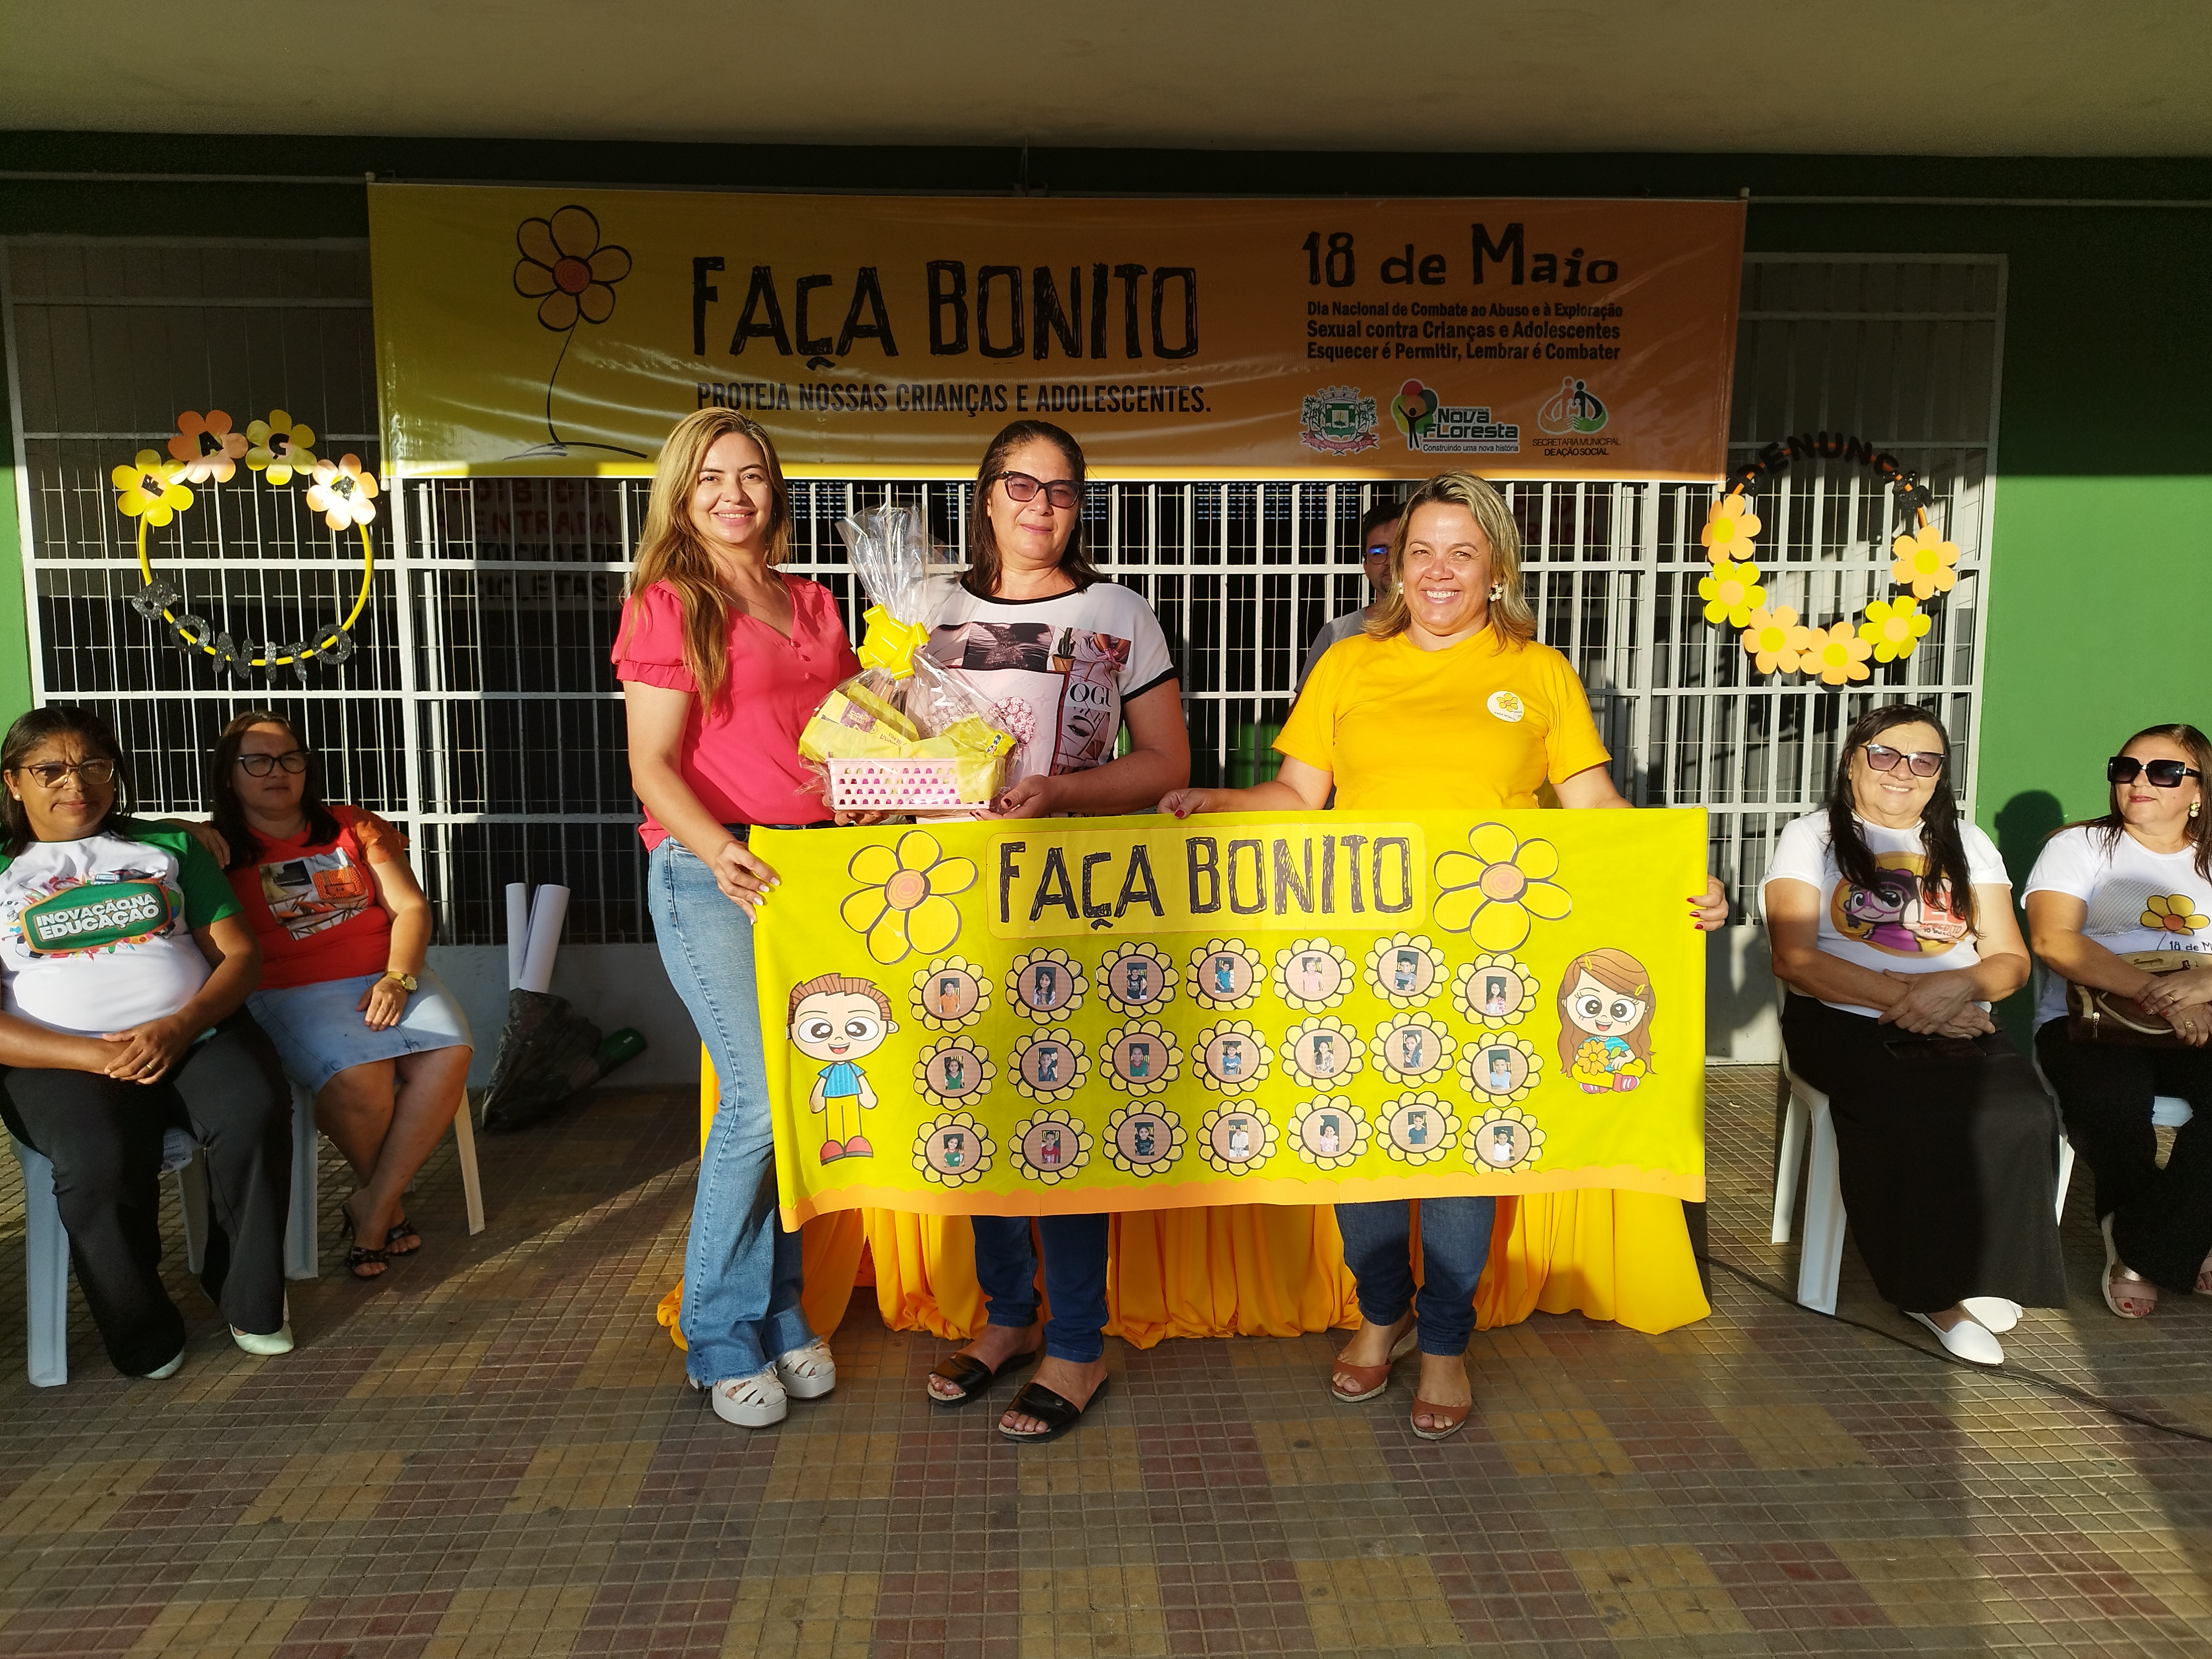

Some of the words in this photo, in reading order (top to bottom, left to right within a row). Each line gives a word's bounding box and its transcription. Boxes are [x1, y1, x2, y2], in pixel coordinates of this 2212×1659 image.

[1302, 231, 1355, 287] 18
[1381, 244, 1447, 285] de
[1472, 223, 1618, 287] Maio
[692, 257, 899, 371] FAÇA
[926, 260, 1199, 360] BONITO
[1307, 301, 1329, 316] Dia
[1333, 301, 1389, 316] Nacional
[1392, 302, 1407, 316] de
[1411, 302, 1468, 316] Combate
[1471, 306, 1486, 316] ao
[1489, 304, 1528, 316] Abuso
[1532, 306, 1540, 316] e
[1543, 302, 1551, 316] à
[1555, 303, 1623, 321] Exploração
[1307, 320, 1361, 337] Sexual
[1366, 321, 1418, 338] contra
[1423, 321, 1495, 342] Crianças
[1499, 325, 1509, 337] e
[1512, 321, 1620, 339] Adolescentes
[1307, 342, 1378, 362] Esquecer
[1382, 341, 1391, 359] é
[1396, 343, 1462, 361] Permitir,
[1467, 342, 1528, 359] Lembrar
[1532, 342, 1541, 359] é
[1546, 343, 1620, 359] Combater
[697, 383, 790, 410] PROTEJA
[799, 383, 888, 411] NOSSAS
[896, 383, 1008, 417] CRIANÇAS
[1017, 385, 1028, 411] E
[1036, 385, 1211, 413] ADOLESCENTES.
[131, 580, 352, 682] BONITO
[1000, 842, 1164, 930] FAÇA
[1186, 834, 1412, 916] BONITO
[35, 899, 131, 927] INOVAÇÃO
[2169, 941, 2180, 951] 18
